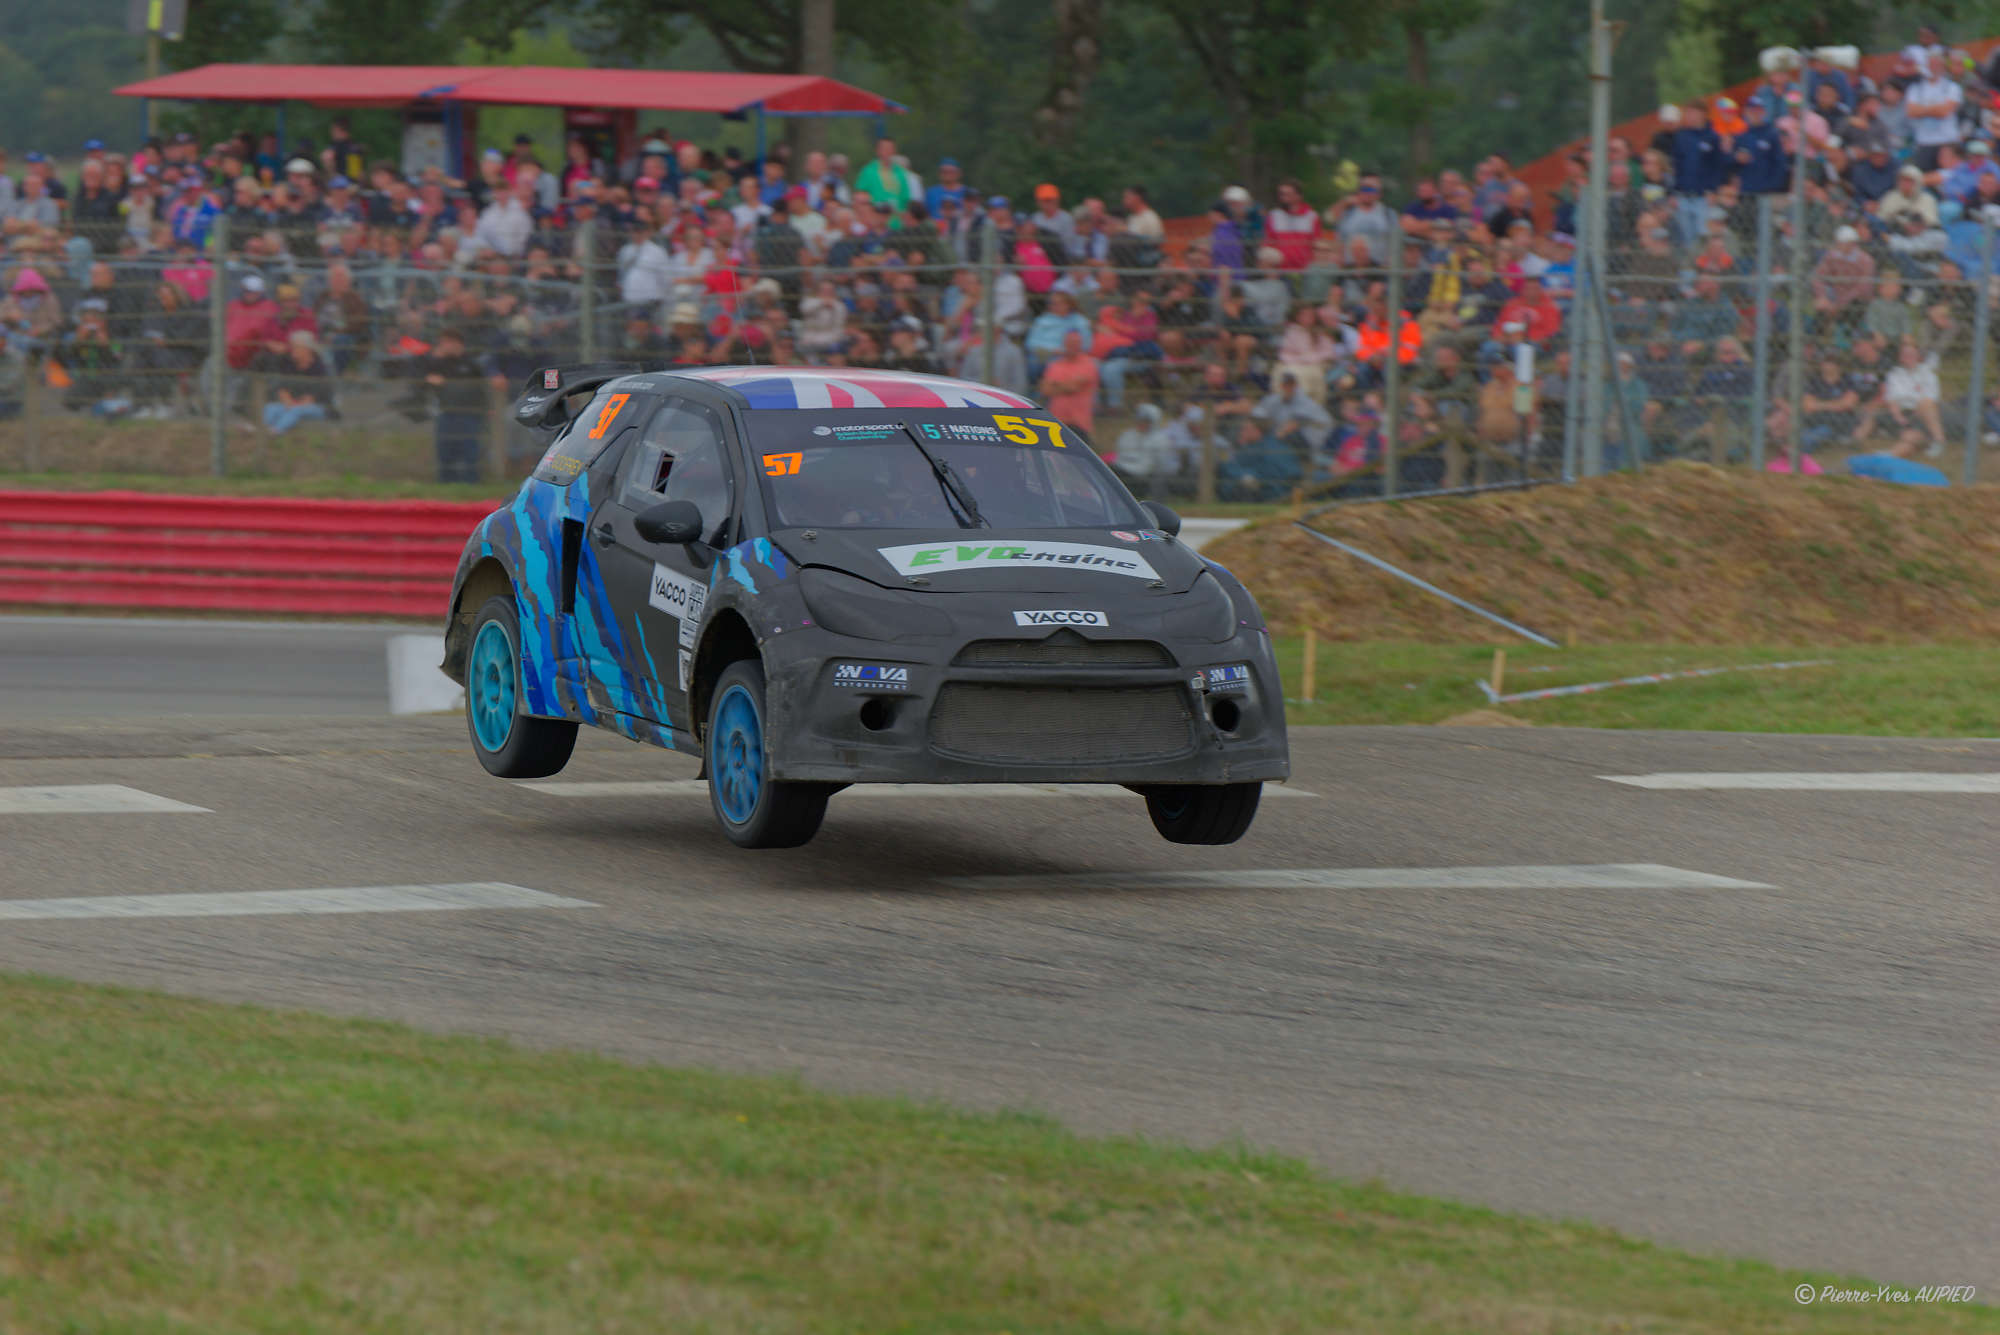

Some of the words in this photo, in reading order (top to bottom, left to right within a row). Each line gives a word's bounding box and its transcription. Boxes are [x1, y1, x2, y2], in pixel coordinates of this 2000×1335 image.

[588, 393, 632, 439] 57
[832, 424, 895, 432] motorsport
[921, 424, 941, 439] 5
[949, 424, 998, 435] NATIONS
[991, 414, 1067, 448] 57
[762, 452, 803, 476] 57
[655, 575, 686, 606] YACCO
[1023, 611, 1098, 624] YACCO
[835, 665, 908, 681] NOVA
